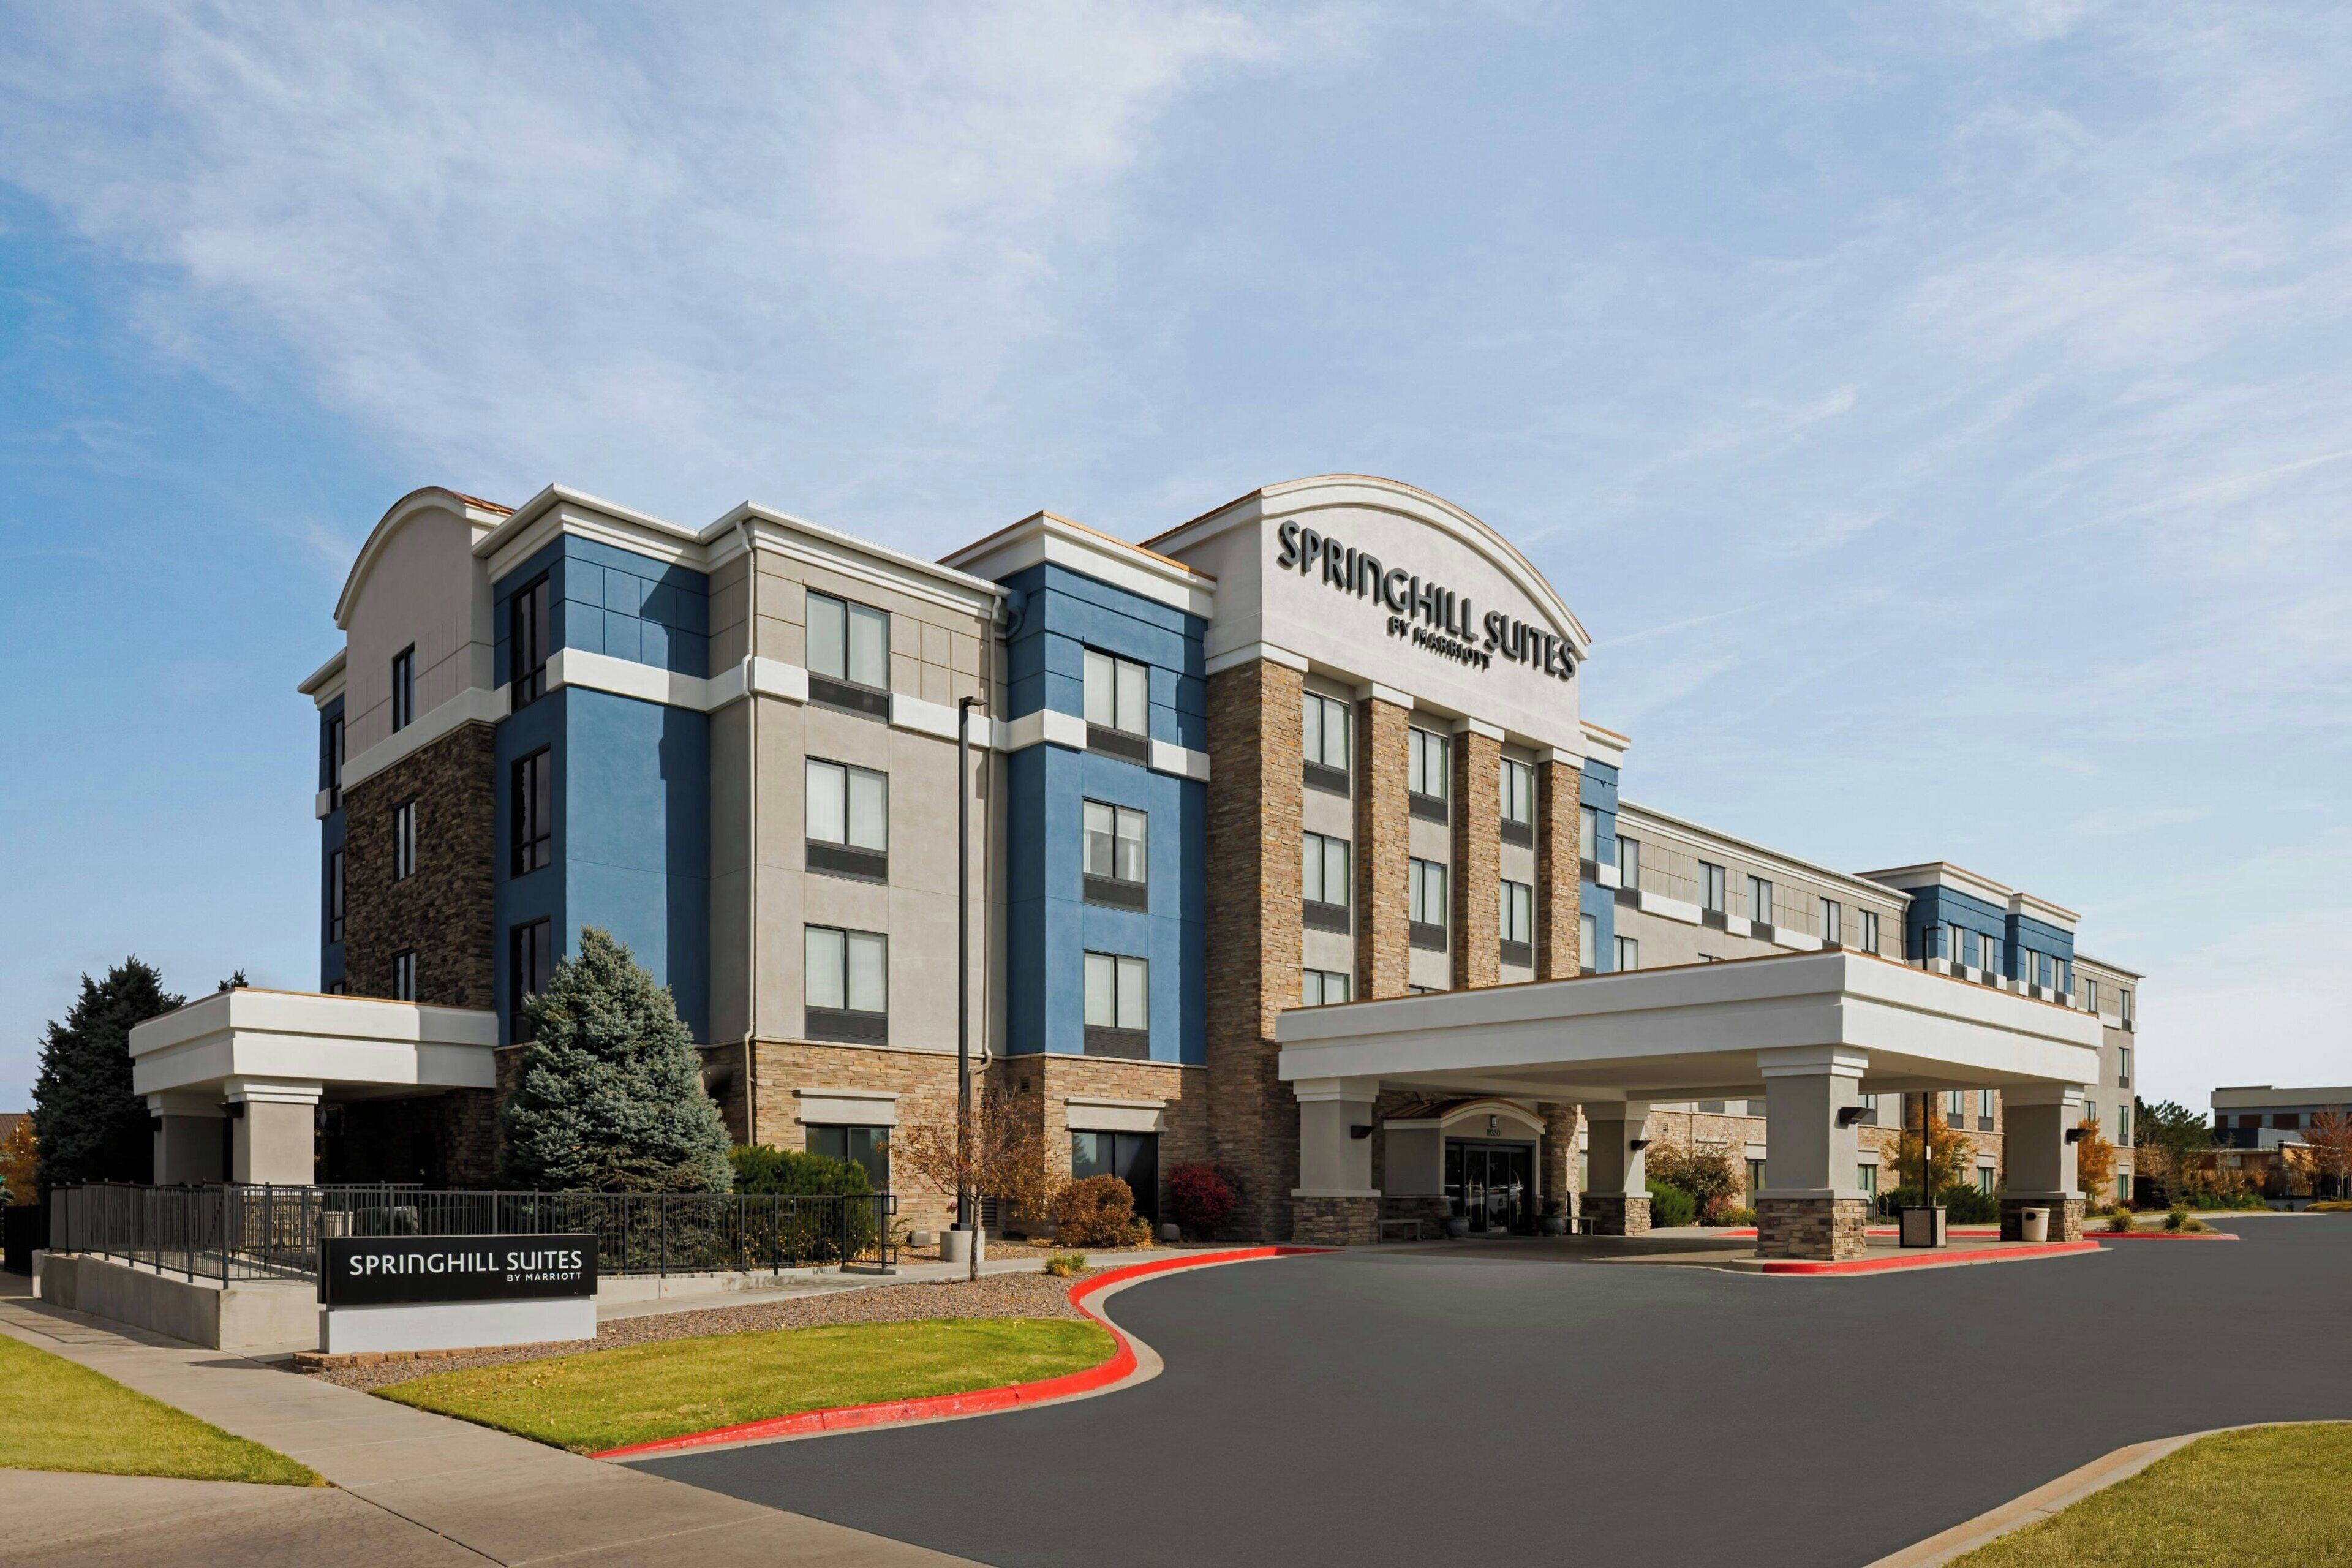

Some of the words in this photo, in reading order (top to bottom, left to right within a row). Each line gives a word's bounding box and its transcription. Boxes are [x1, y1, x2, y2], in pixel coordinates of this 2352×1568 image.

[1277, 519, 1478, 643] SPRINGHILL
[1483, 610, 1576, 680] SUITES
[1387, 616, 1410, 636] BY
[1414, 626, 1493, 671] MARRIOTT
[350, 1251, 499, 1275] SPRINGHILL
[507, 1250, 582, 1270] SUITES
[526, 1272, 582, 1281] MARRIOTT
